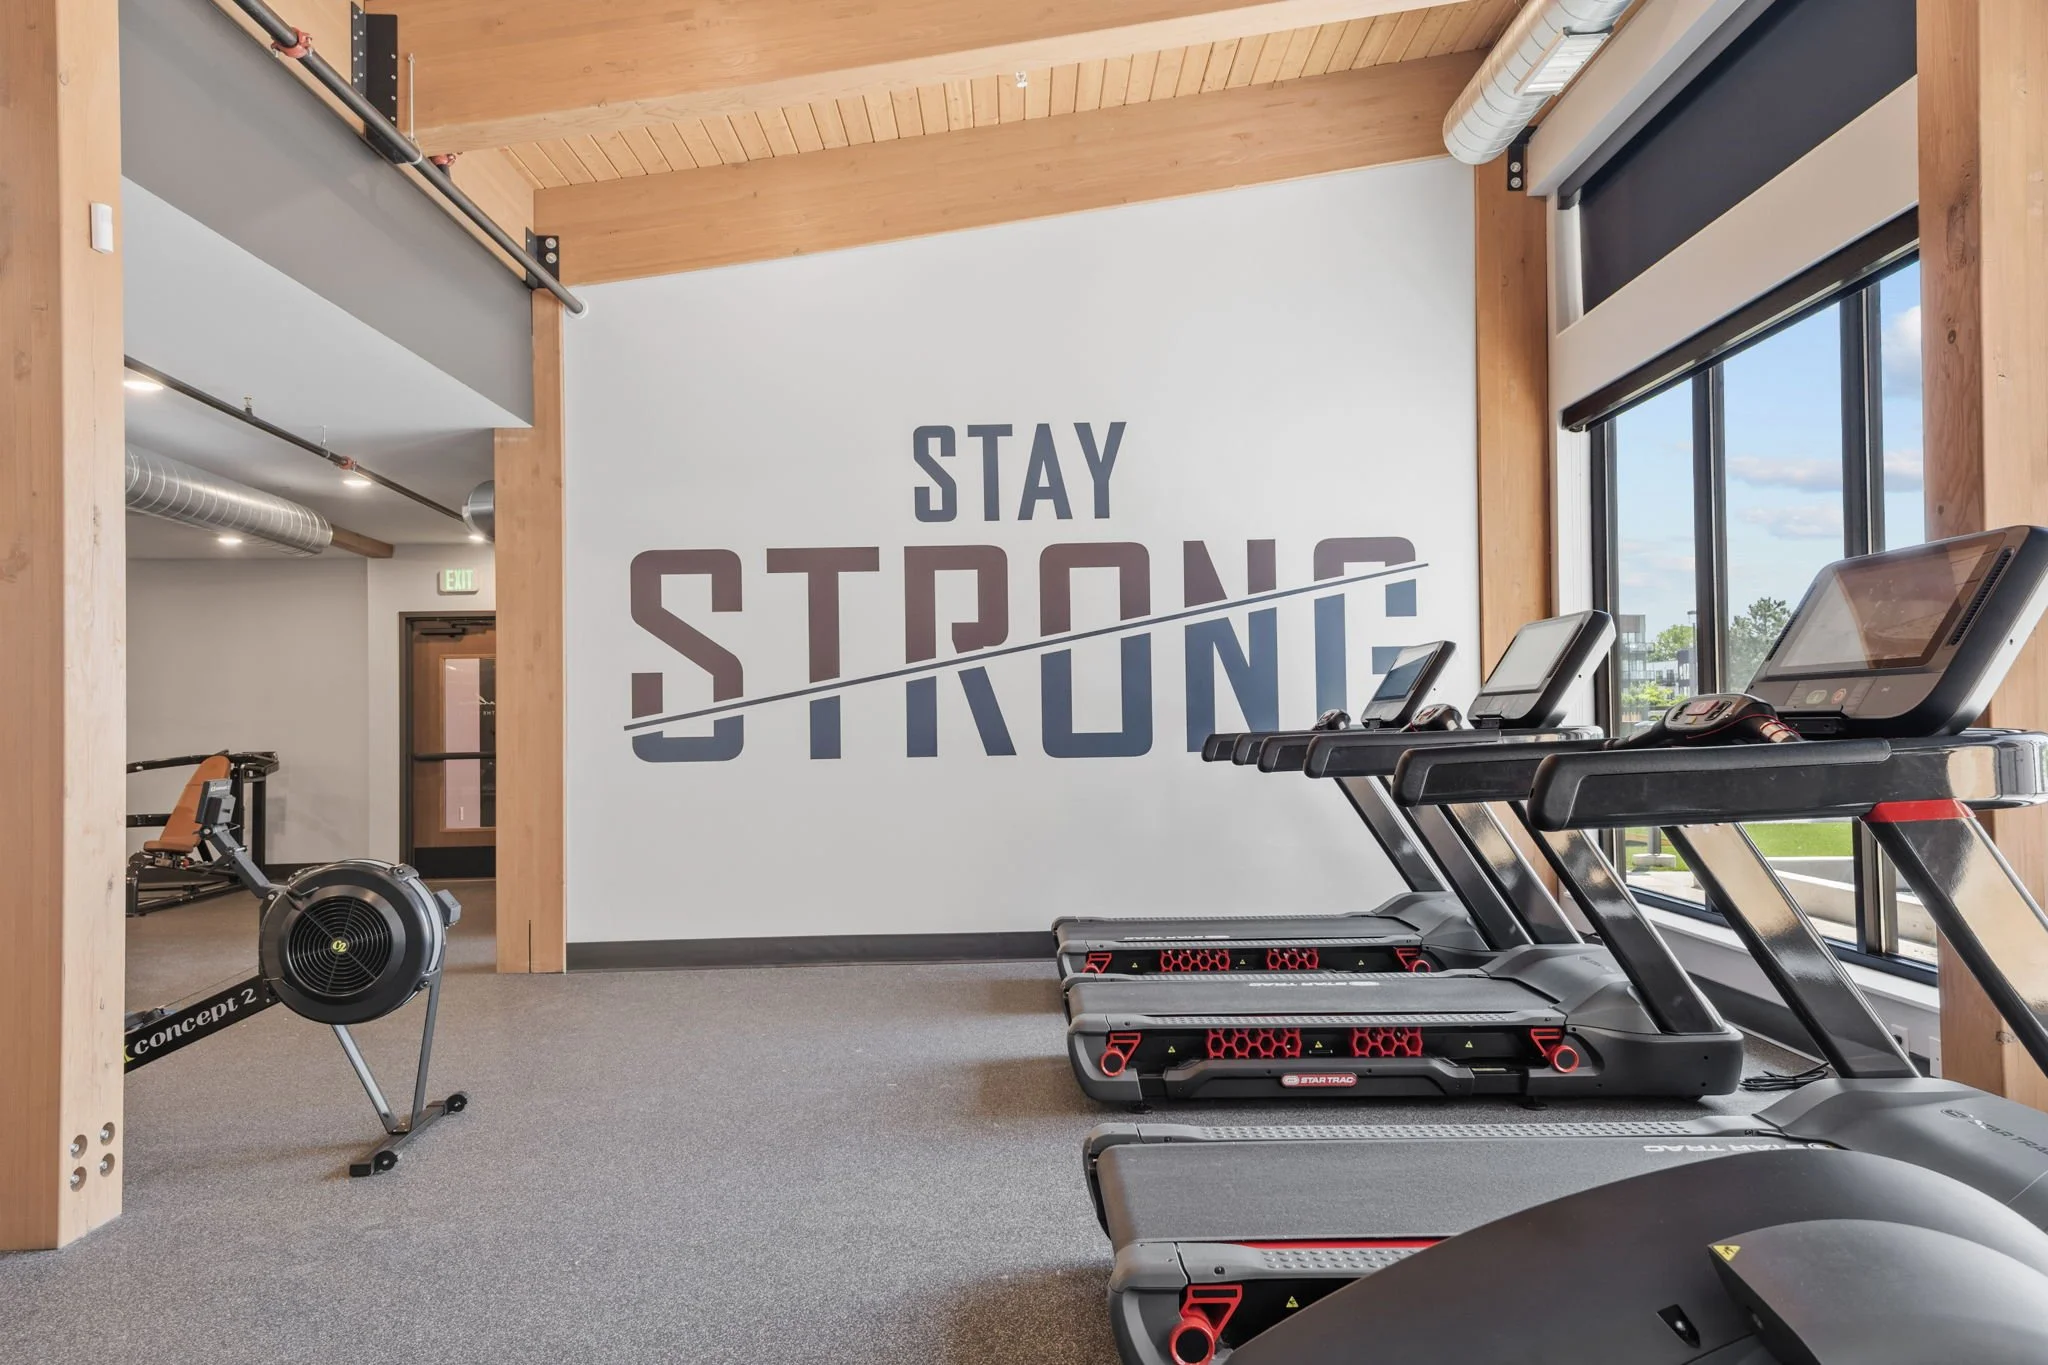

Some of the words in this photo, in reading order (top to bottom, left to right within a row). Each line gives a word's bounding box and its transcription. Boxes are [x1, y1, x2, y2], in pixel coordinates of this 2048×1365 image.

[913, 421, 1127, 523] STAY
[446, 568, 474, 591] EXIT
[630, 536, 1417, 764] STRONG
[134, 996, 239, 1055] concept
[240, 988, 257, 1005] 2
[1300, 1076, 1326, 1084] STAR
[1327, 1076, 1354, 1084] TRAC
